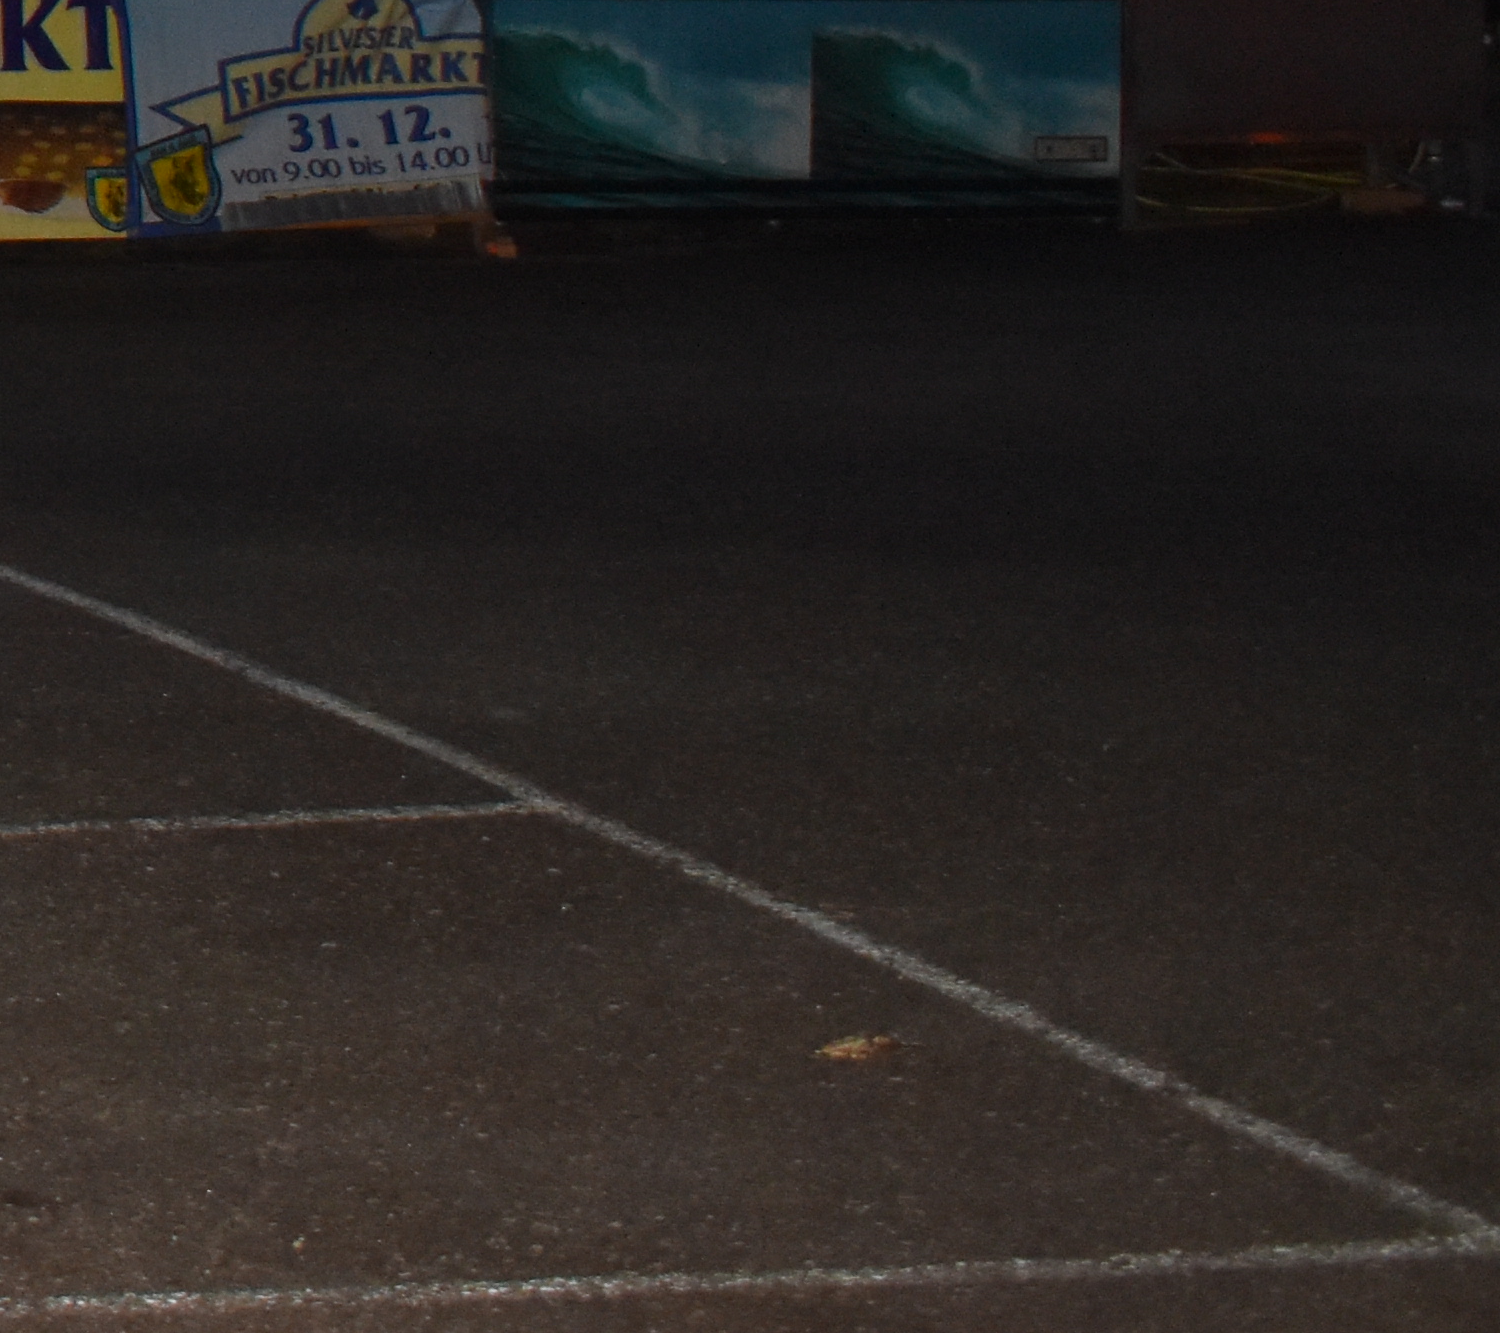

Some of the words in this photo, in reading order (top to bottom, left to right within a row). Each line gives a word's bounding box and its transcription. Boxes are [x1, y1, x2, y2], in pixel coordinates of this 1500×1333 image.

[301, 25, 416, 58] SILVESTER
[231, 166, 277, 186] von
[282, 156, 342, 183] 9.00
[349, 154, 386, 177] bis
[396, 144, 471, 174] 14.00
